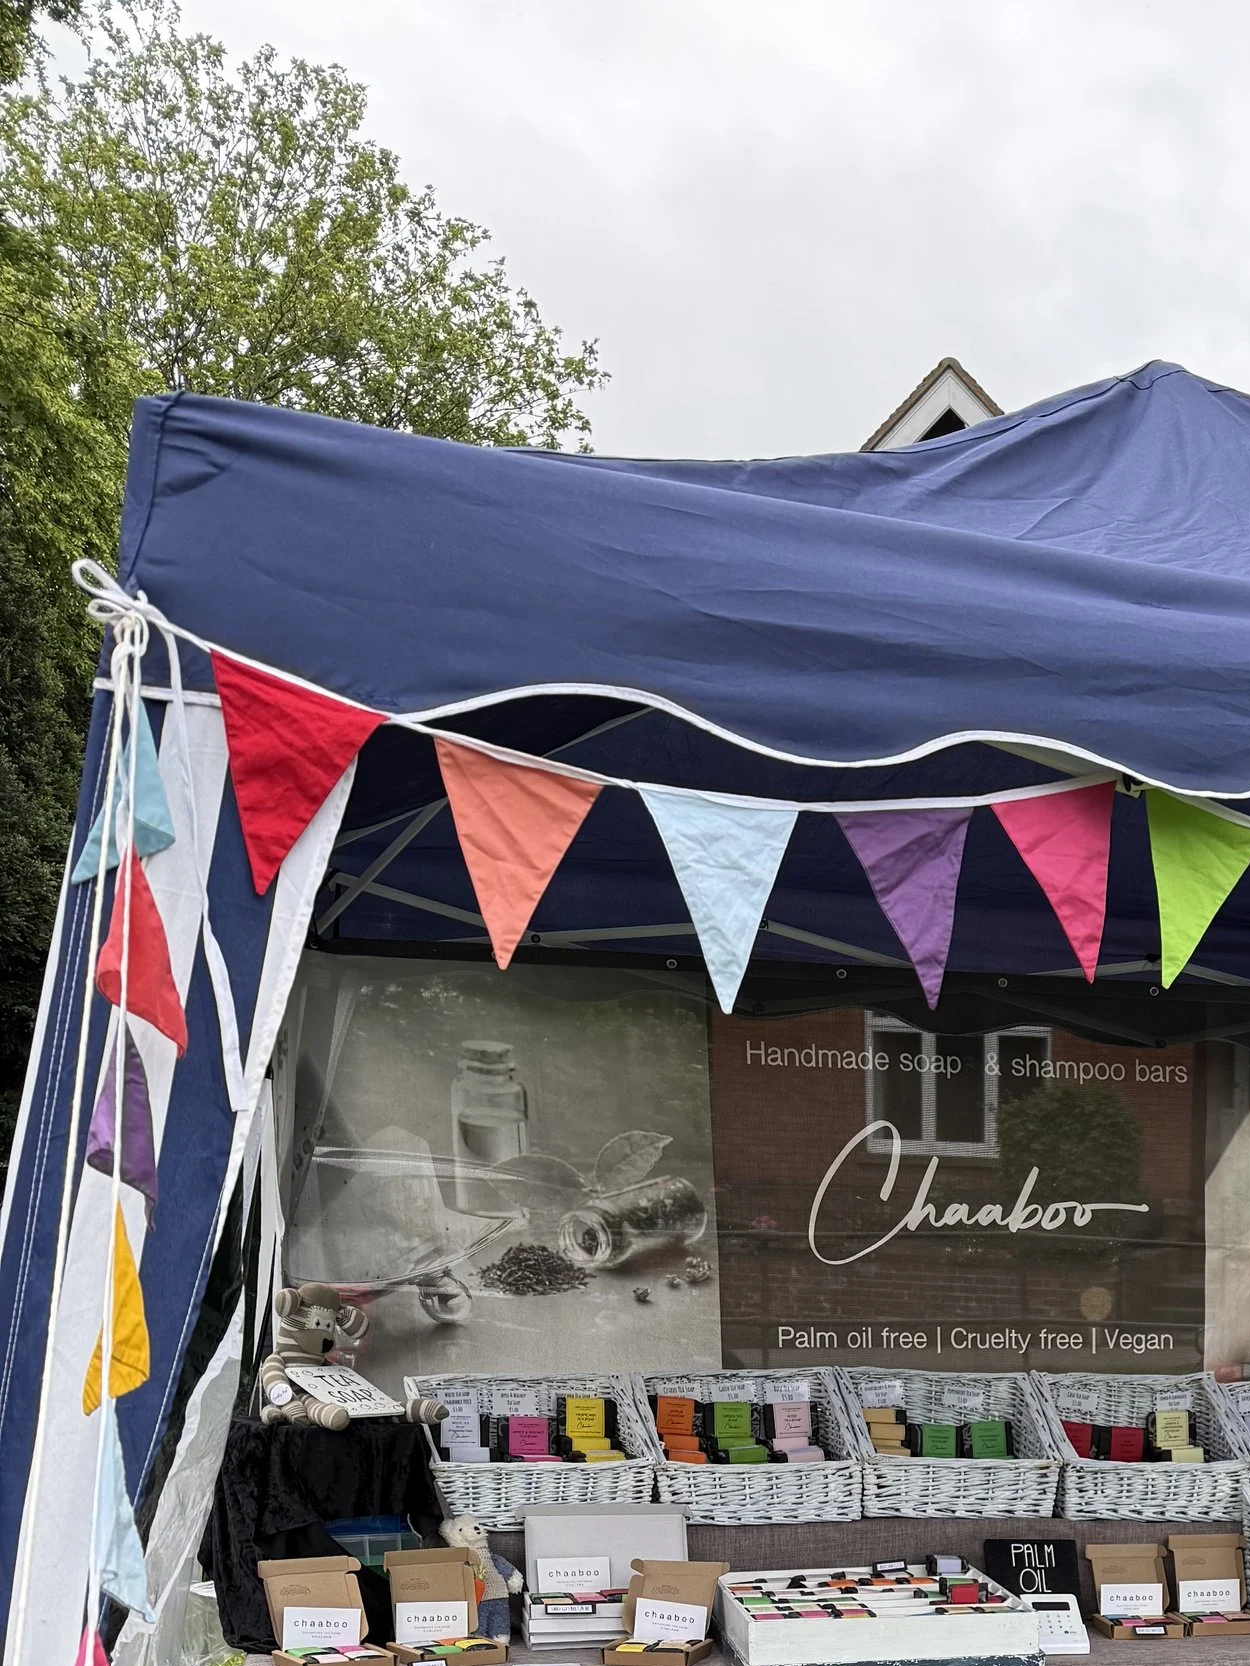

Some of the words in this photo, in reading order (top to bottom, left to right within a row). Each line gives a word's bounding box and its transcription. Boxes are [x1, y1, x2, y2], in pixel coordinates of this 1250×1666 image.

[745, 1040, 890, 1070] Handmade
[899, 1050, 962, 1079] soap
[984, 1051, 1002, 1076] &
[1011, 1053, 1126, 1084] shampoo
[1135, 1058, 1188, 1083] bars
[809, 1119, 1149, 1265] Chaaboo
[777, 1326, 838, 1348] Palm
[847, 1327, 872, 1348] oil
[881, 1328, 928, 1348] free
[950, 1328, 1031, 1354] Cruelty
[1039, 1328, 1083, 1349] free
[1104, 1328, 1174, 1354] Vegan
[313, 1373, 361, 1387] TEA
[328, 1388, 377, 1404] SOAP
[1010, 1543, 1056, 1568] PALM
[548, 1569, 600, 1578] chaaboo
[1018, 1568, 1052, 1593] OIL
[1109, 1594, 1154, 1602] chaaboo
[1187, 1590, 1231, 1598] chaaboo
[293, 1619, 348, 1628] chaaboo
[406, 1615, 458, 1623] chaaboo
[644, 1610, 695, 1624] chaaboo
